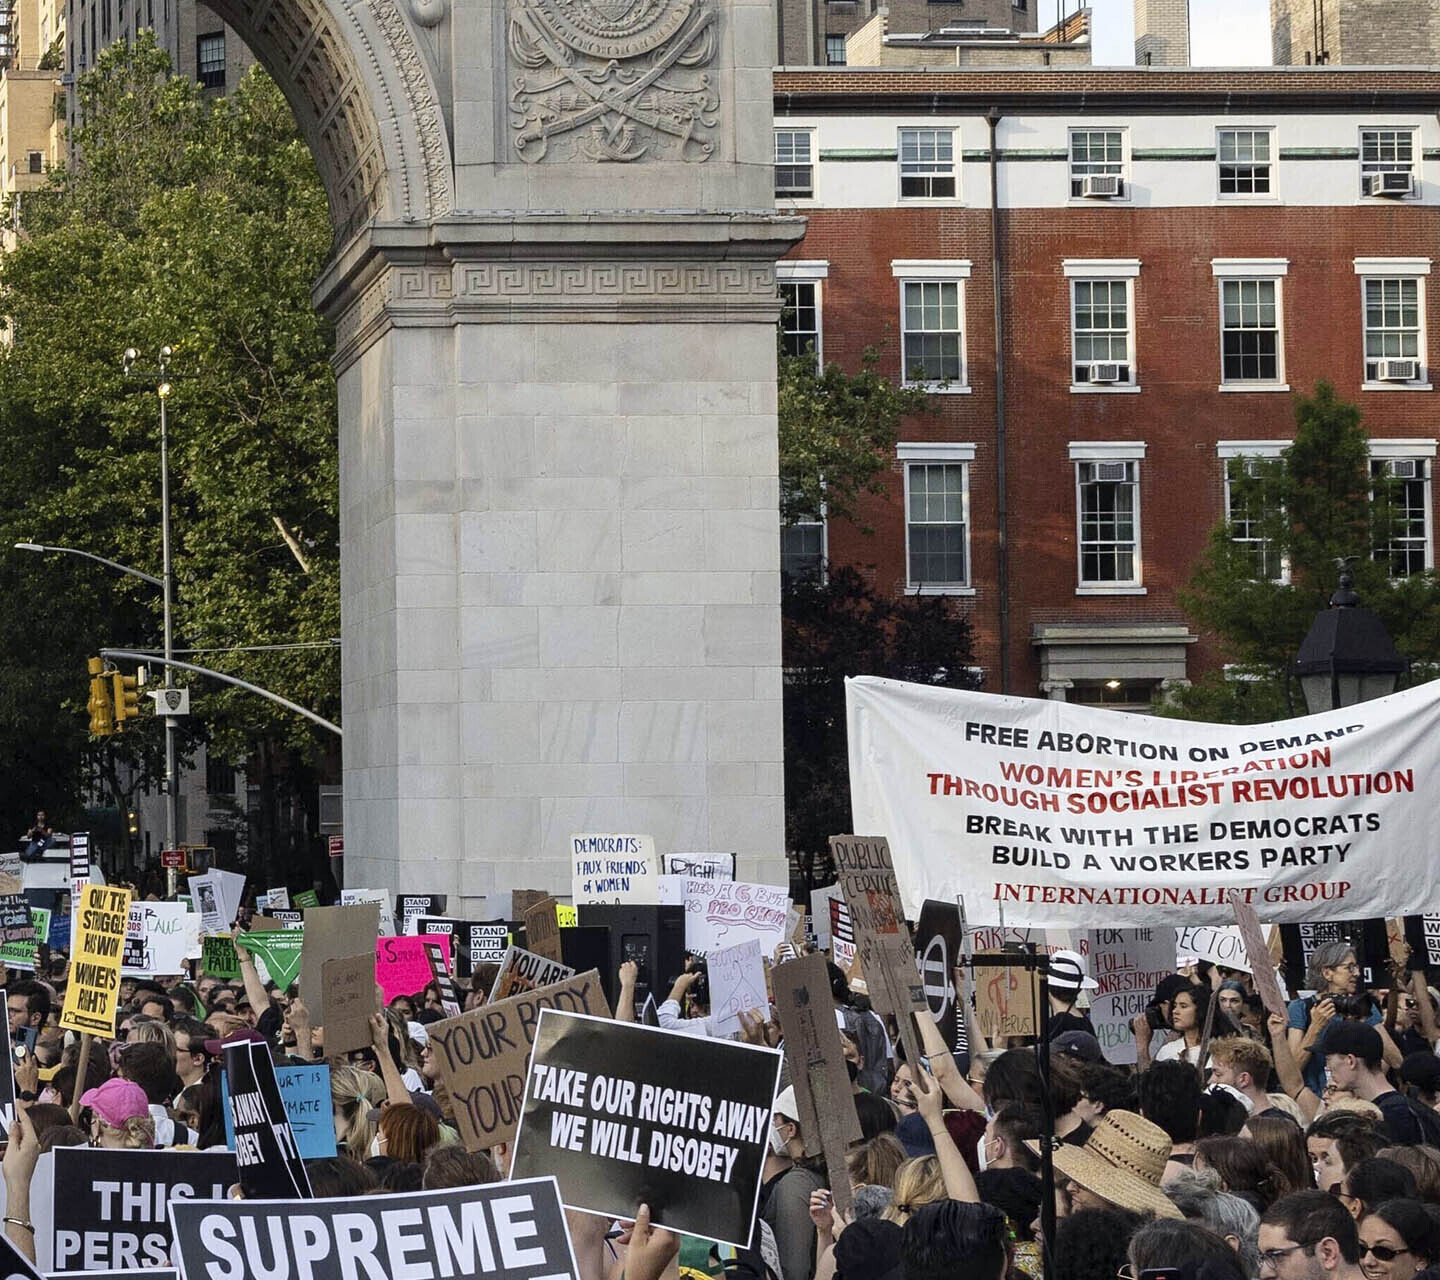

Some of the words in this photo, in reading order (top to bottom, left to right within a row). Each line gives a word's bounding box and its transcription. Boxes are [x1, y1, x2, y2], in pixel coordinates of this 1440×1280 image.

[966, 722, 1028, 748] FREE
[1037, 730, 1178, 760] ABORTION
[1189, 747, 1229, 762] ON
[1240, 724, 1365, 754] DEMAND
[1000, 762, 1143, 788] WOMEN'S
[927, 773, 1059, 812] THROUGH
[1067, 782, 1224, 814] SOCIALIST
[1232, 769, 1414, 803] REVOLUTION
[967, 815, 1052, 843] BREAK
[1061, 827, 1132, 846] WITH
[1144, 824, 1198, 844] THE
[1210, 813, 1380, 841] DEMOCRATS
[993, 845, 1070, 869] BUILD
[1083, 855, 1101, 869] A
[1110, 850, 1250, 871] WORKERS
[1261, 843, 1352, 868] PARTY
[993, 883, 1257, 905] INTERNATIONALIST
[1264, 881, 1352, 902] GROUP
